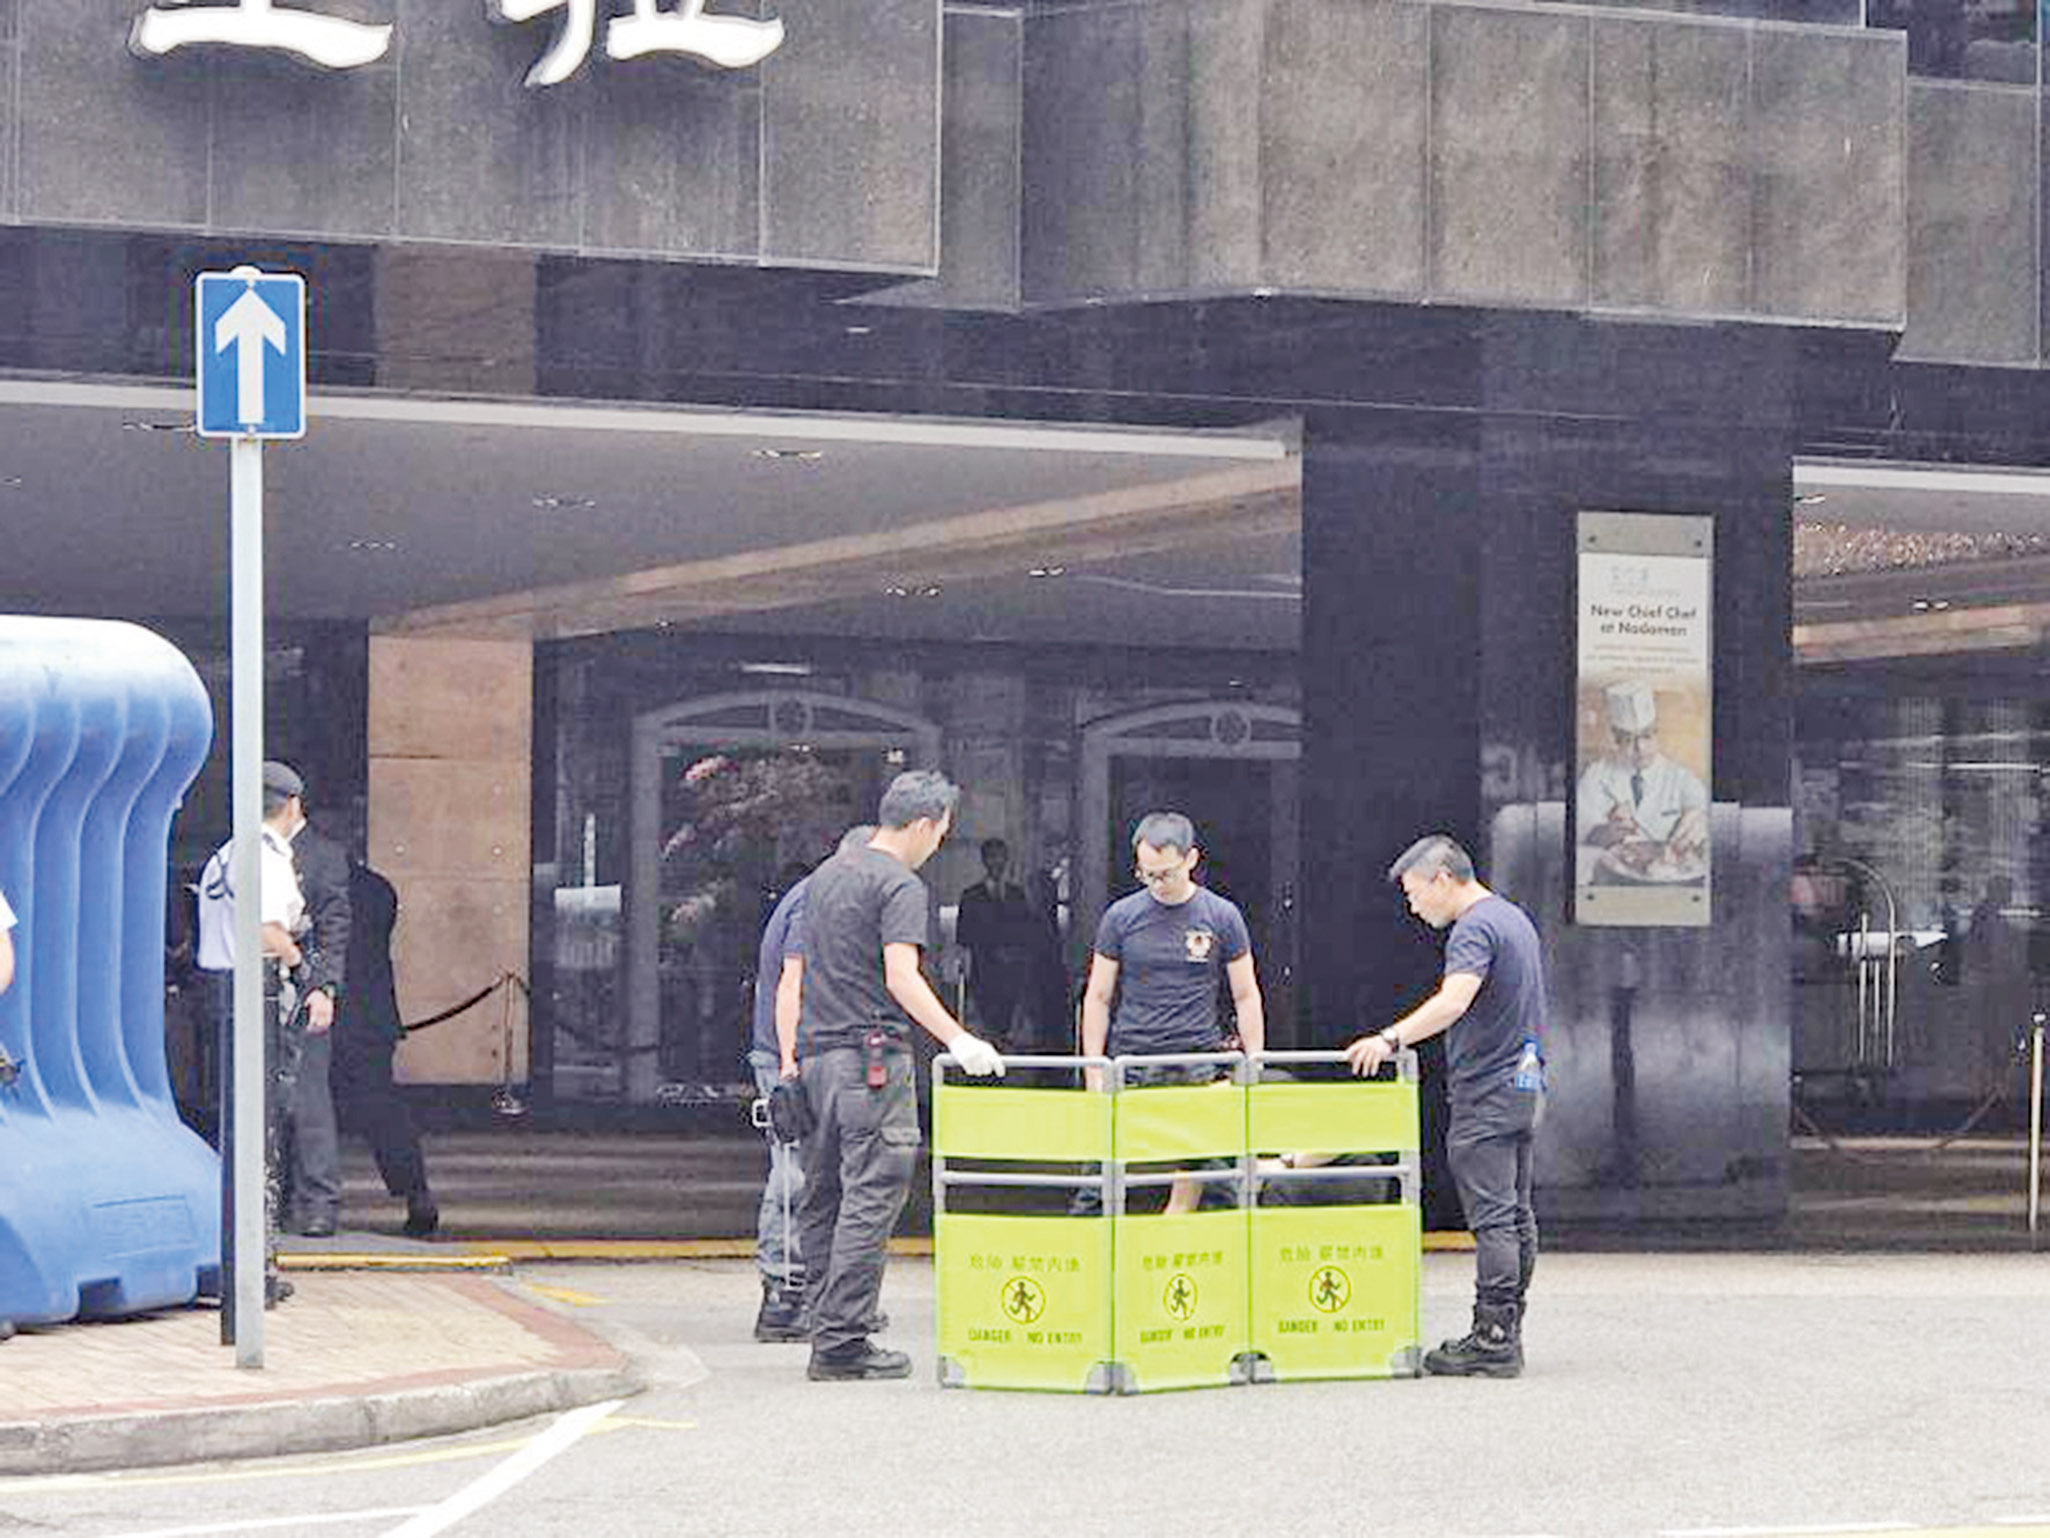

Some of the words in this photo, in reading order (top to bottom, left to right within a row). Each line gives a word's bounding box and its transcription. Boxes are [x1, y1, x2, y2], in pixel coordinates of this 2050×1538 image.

[1278, 1320, 1318, 1333] DANGER
[1334, 1320, 1348, 1331] NO
[1352, 1318, 1385, 1332] ENTRY
[968, 1328, 1011, 1342] DANGER
[1027, 1332, 1043, 1343] NO
[1047, 1332, 1082, 1344] ENTRY
